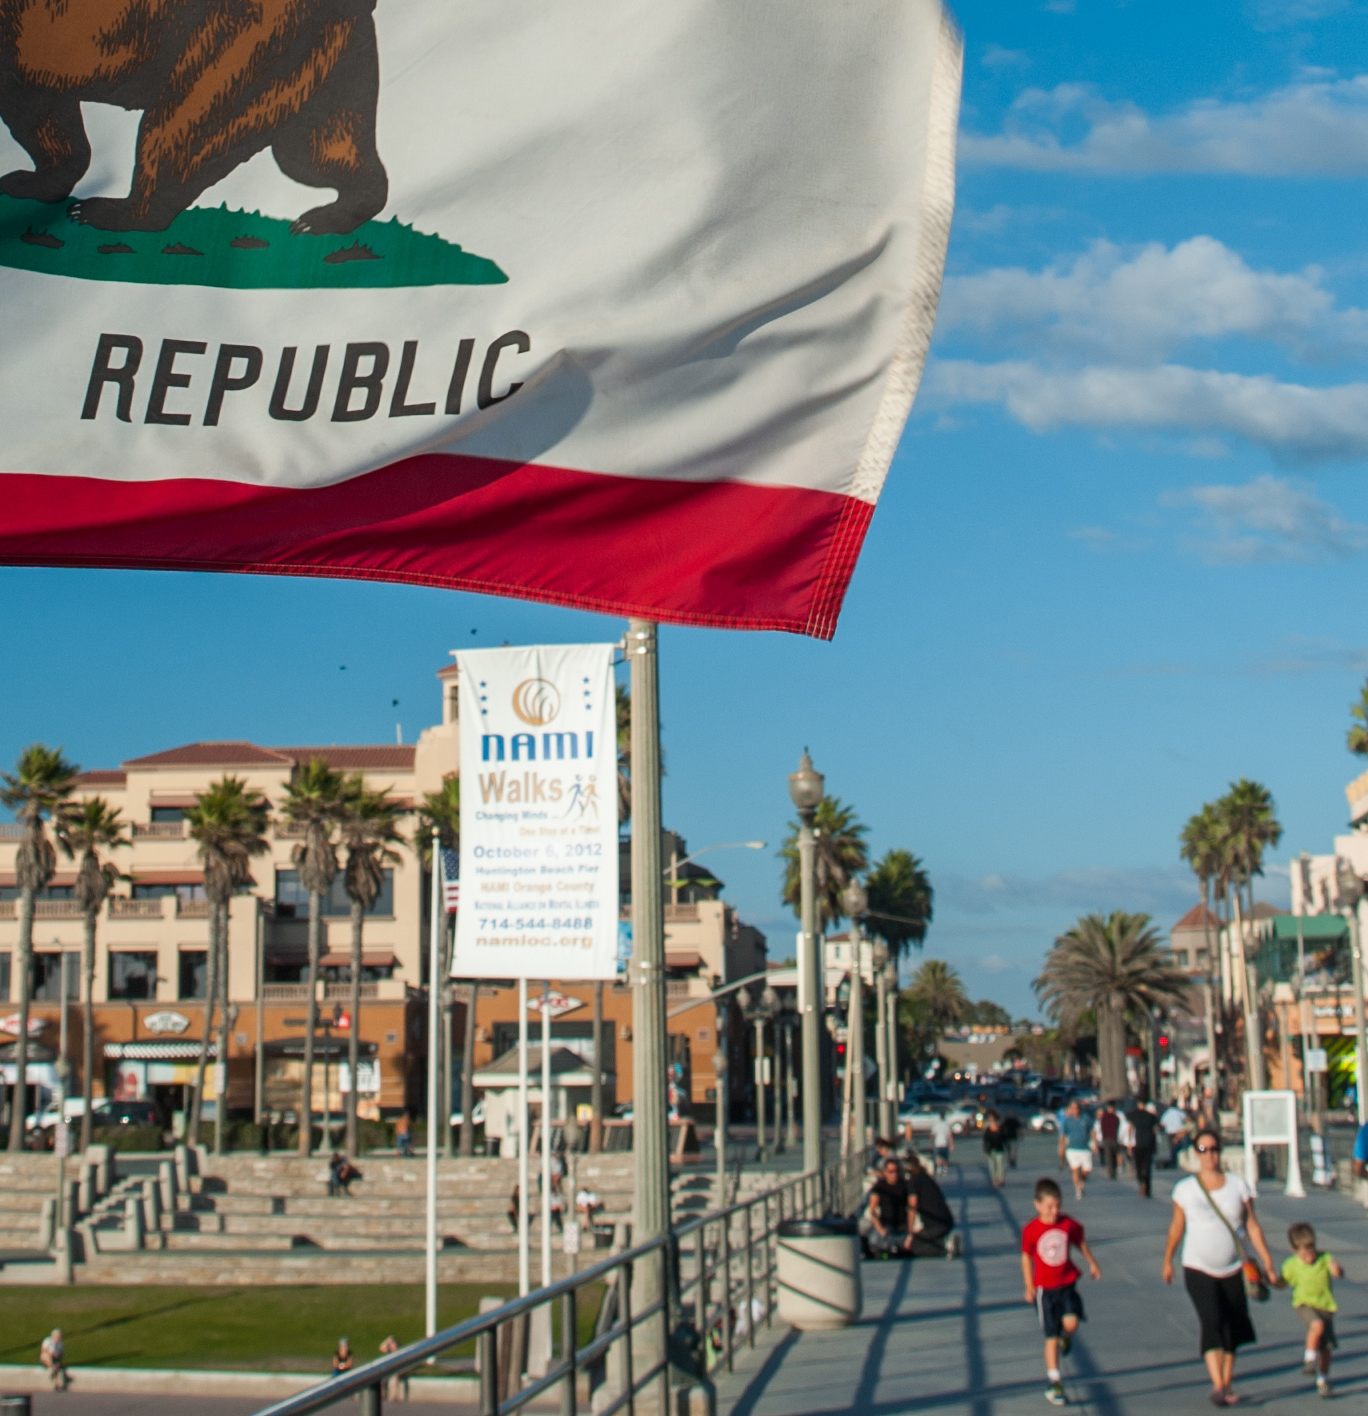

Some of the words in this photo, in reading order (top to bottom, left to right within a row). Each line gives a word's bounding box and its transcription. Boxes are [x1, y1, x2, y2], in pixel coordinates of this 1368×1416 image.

[81, 330, 532, 428] REPUBLIC
[479, 770, 563, 804] Walks
[473, 845, 539, 859] October
[545, 845, 559, 859] 6,
[565, 842, 603, 857] 2012
[479, 916, 594, 931] 714-544-8488
[475, 934, 594, 950] namioc.org
